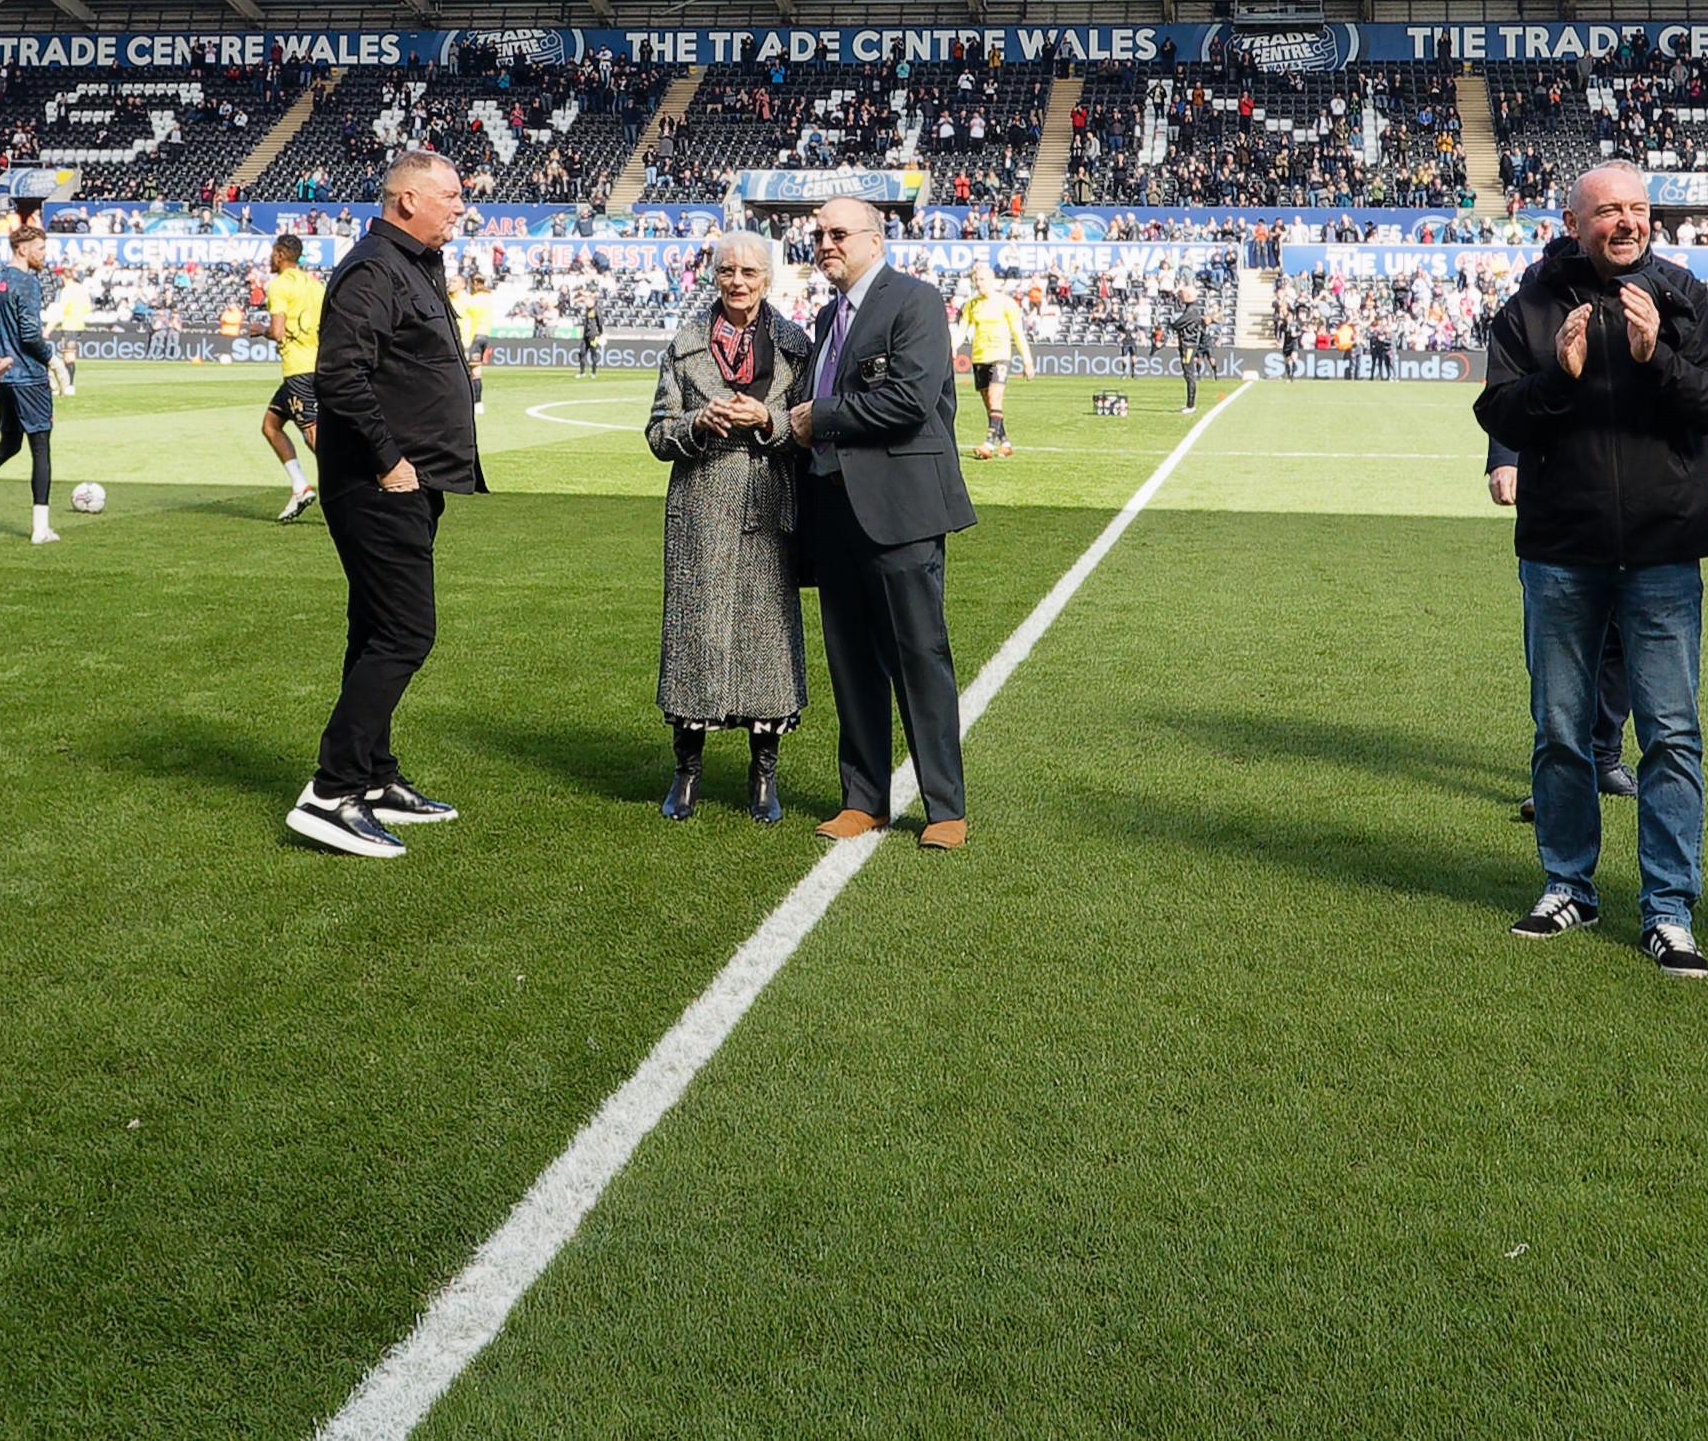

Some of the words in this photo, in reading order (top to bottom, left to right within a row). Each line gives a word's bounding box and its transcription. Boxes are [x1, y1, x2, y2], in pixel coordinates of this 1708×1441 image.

[126, 34, 273, 66] CENTRE
[274, 34, 401, 66] WALES
[626, 32, 697, 62] THE
[1016, 29, 1158, 60] WALES
[1241, 32, 1321, 50] TRADE
[1252, 43, 1315, 64] CENTRE
[802, 181, 863, 198] CENTRE
[123, 240, 224, 264] CENTRE
[1326, 252, 1377, 276] THE
[1384, 252, 1447, 276] UK'S
[1264, 352, 1350, 379] Solar
